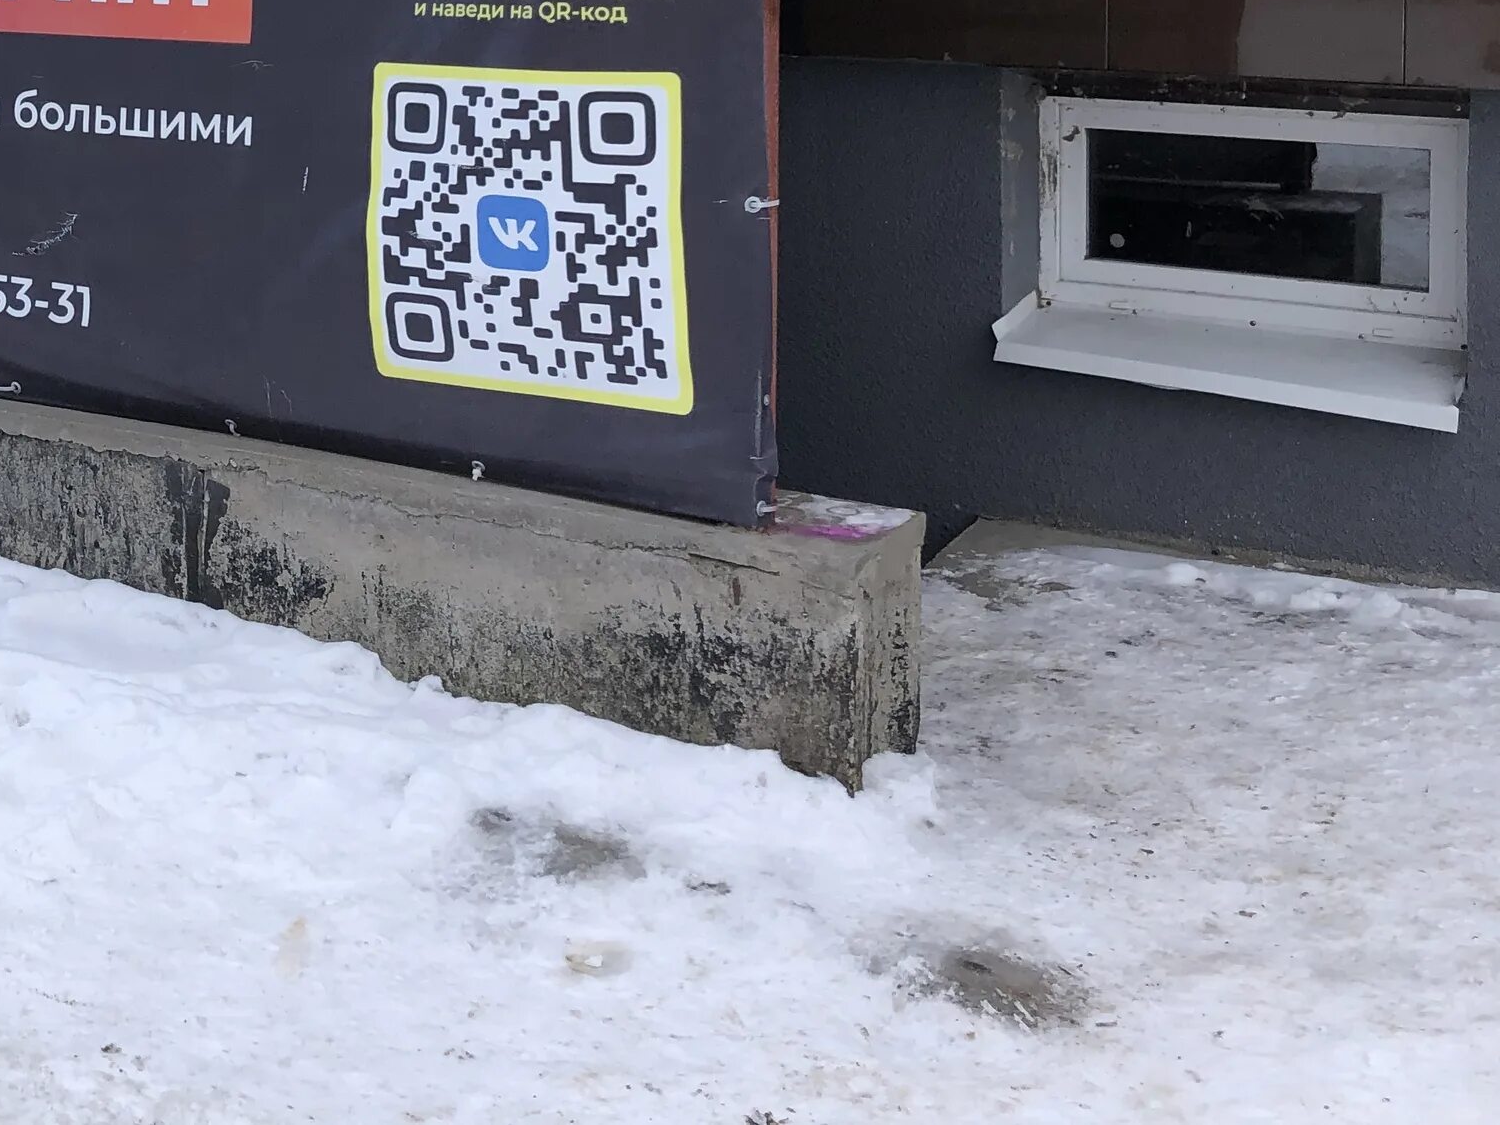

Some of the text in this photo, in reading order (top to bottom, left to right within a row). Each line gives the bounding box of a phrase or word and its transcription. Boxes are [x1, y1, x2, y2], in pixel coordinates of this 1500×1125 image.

[414, 2, 627, 24] и наведи на QR-код
[13, 89, 253, 146] большими
